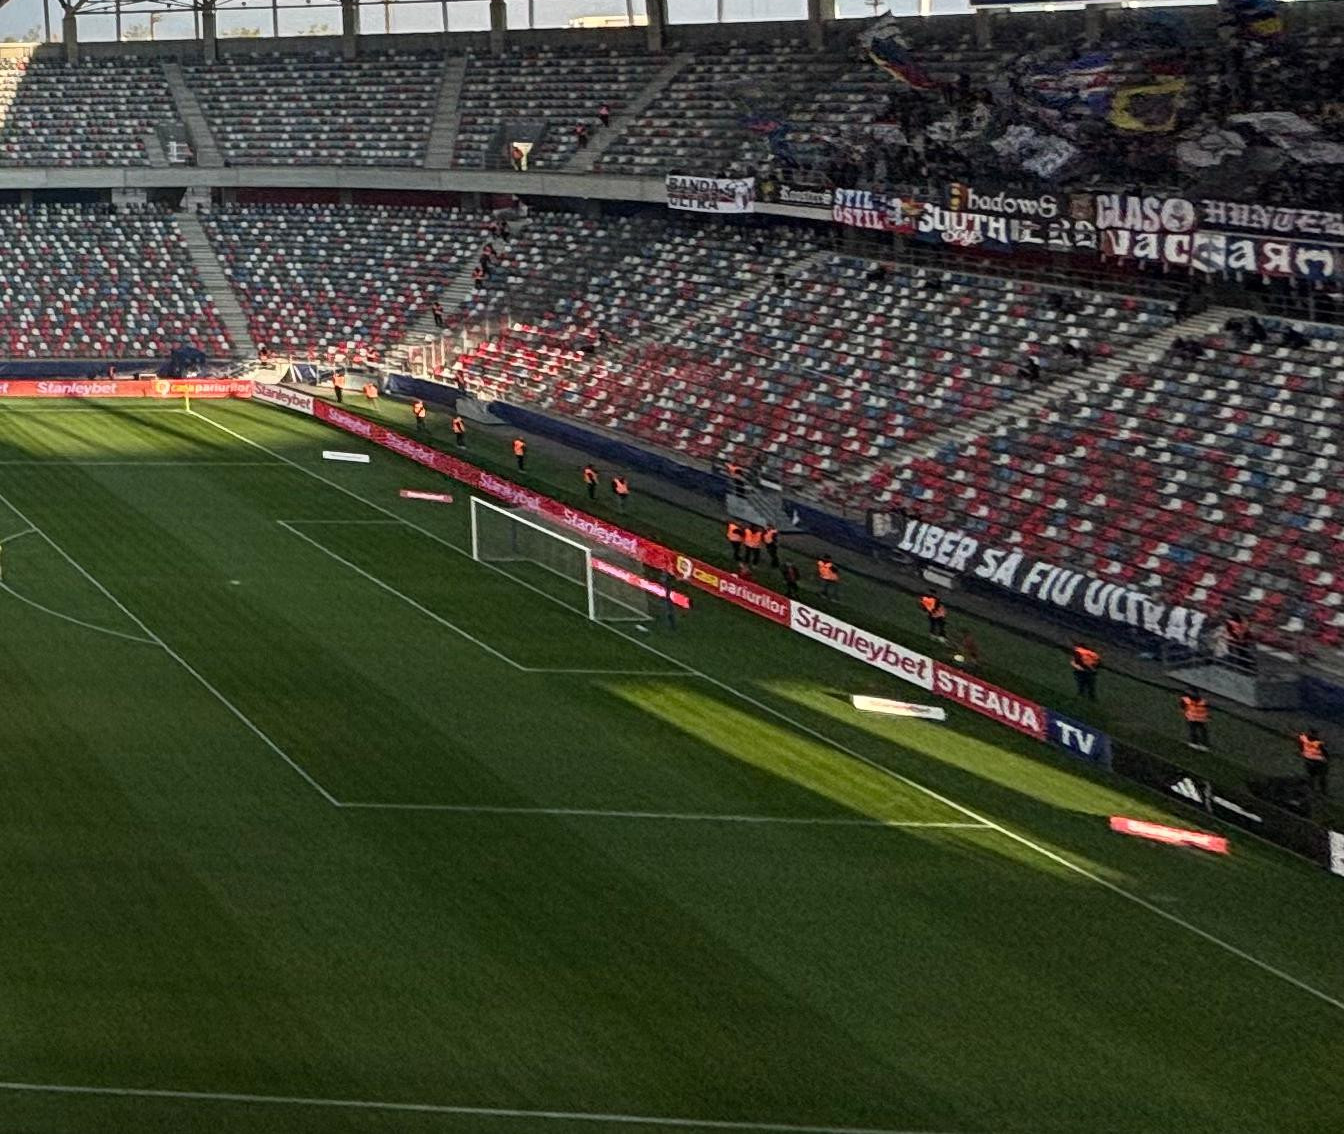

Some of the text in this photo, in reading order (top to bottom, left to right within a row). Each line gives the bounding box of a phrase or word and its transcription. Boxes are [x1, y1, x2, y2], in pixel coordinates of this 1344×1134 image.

[37, 381, 117, 395] Stanleybet
[898, 519, 979, 572] LIBER
[1020, 561, 1085, 606] FIU
[795, 606, 928, 681] Stanleybet
[935, 668, 1096, 755] STEAUA TV
